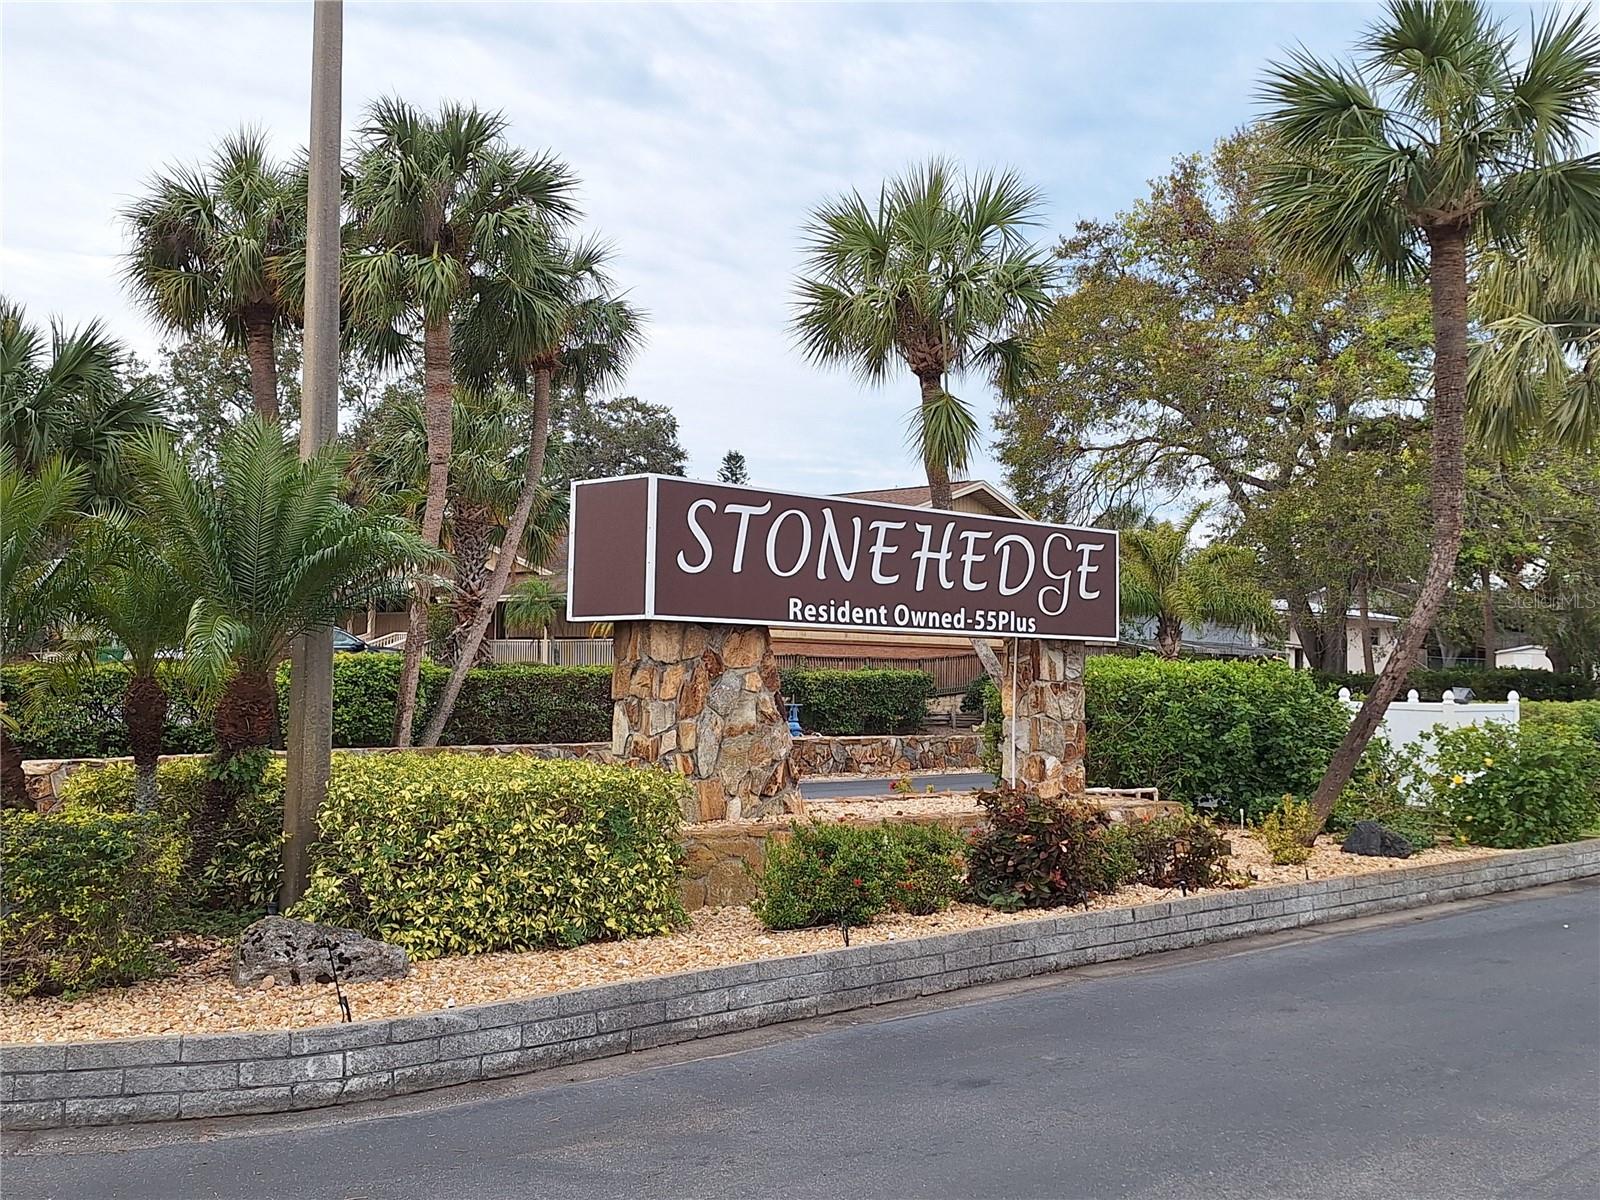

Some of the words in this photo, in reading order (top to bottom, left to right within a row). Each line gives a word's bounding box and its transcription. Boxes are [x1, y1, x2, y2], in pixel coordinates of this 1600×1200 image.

[677, 498, 1104, 616] STONEHEDGE
[788, 597, 888, 625] Resident
[893, 604, 1036, 633] Owned-55Plus
